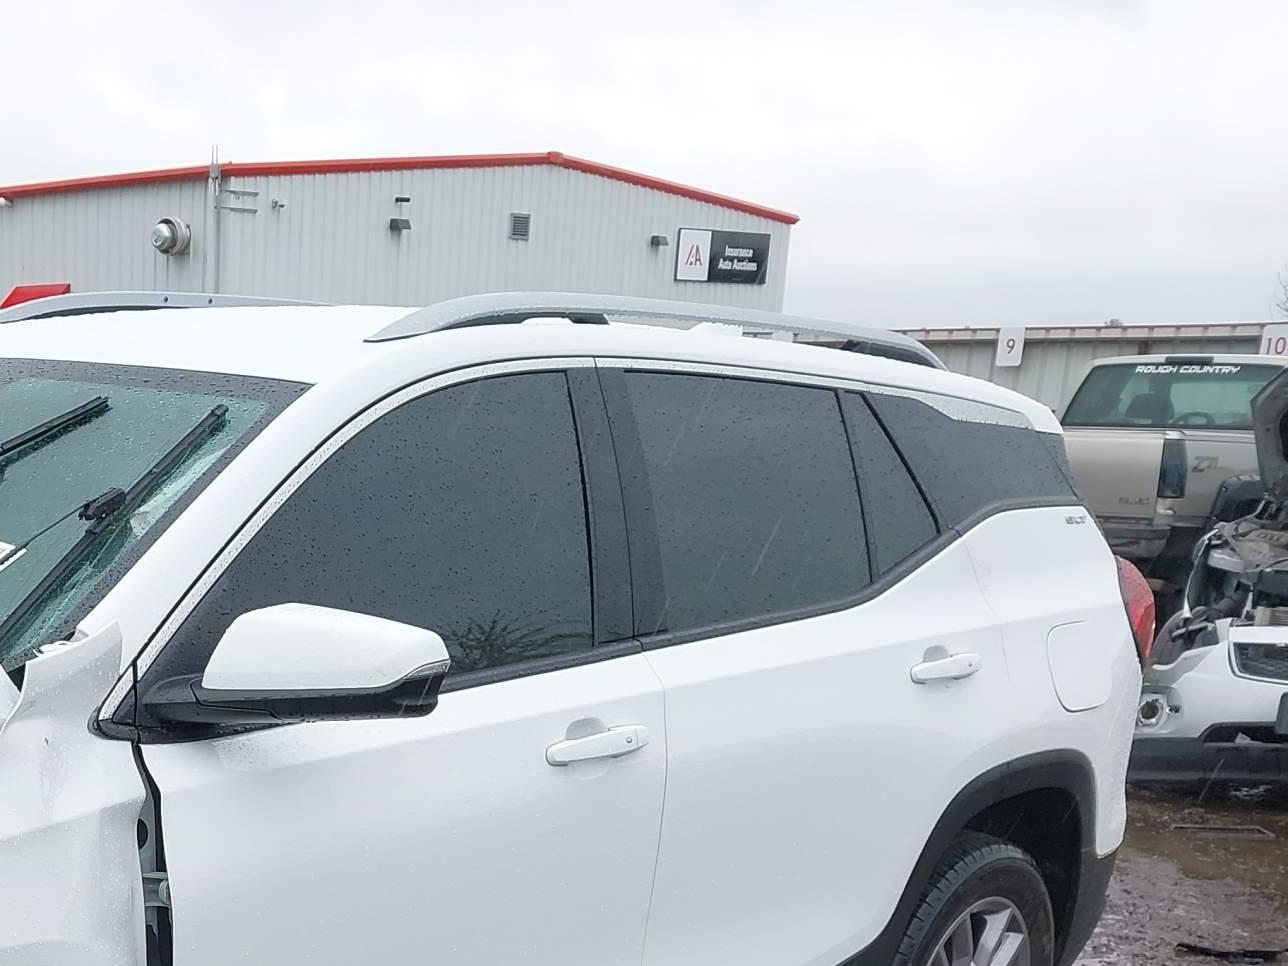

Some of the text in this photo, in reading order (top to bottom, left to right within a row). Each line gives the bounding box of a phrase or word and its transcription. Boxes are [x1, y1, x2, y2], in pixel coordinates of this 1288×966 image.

[725, 244, 753, 257] Insurance
[718, 258, 758, 271] Auto Auctions
[1006, 338, 1016, 354] 9
[1267, 336, 1287, 355] 10
[1135, 365, 1241, 374] ROUGH COUNTRY
